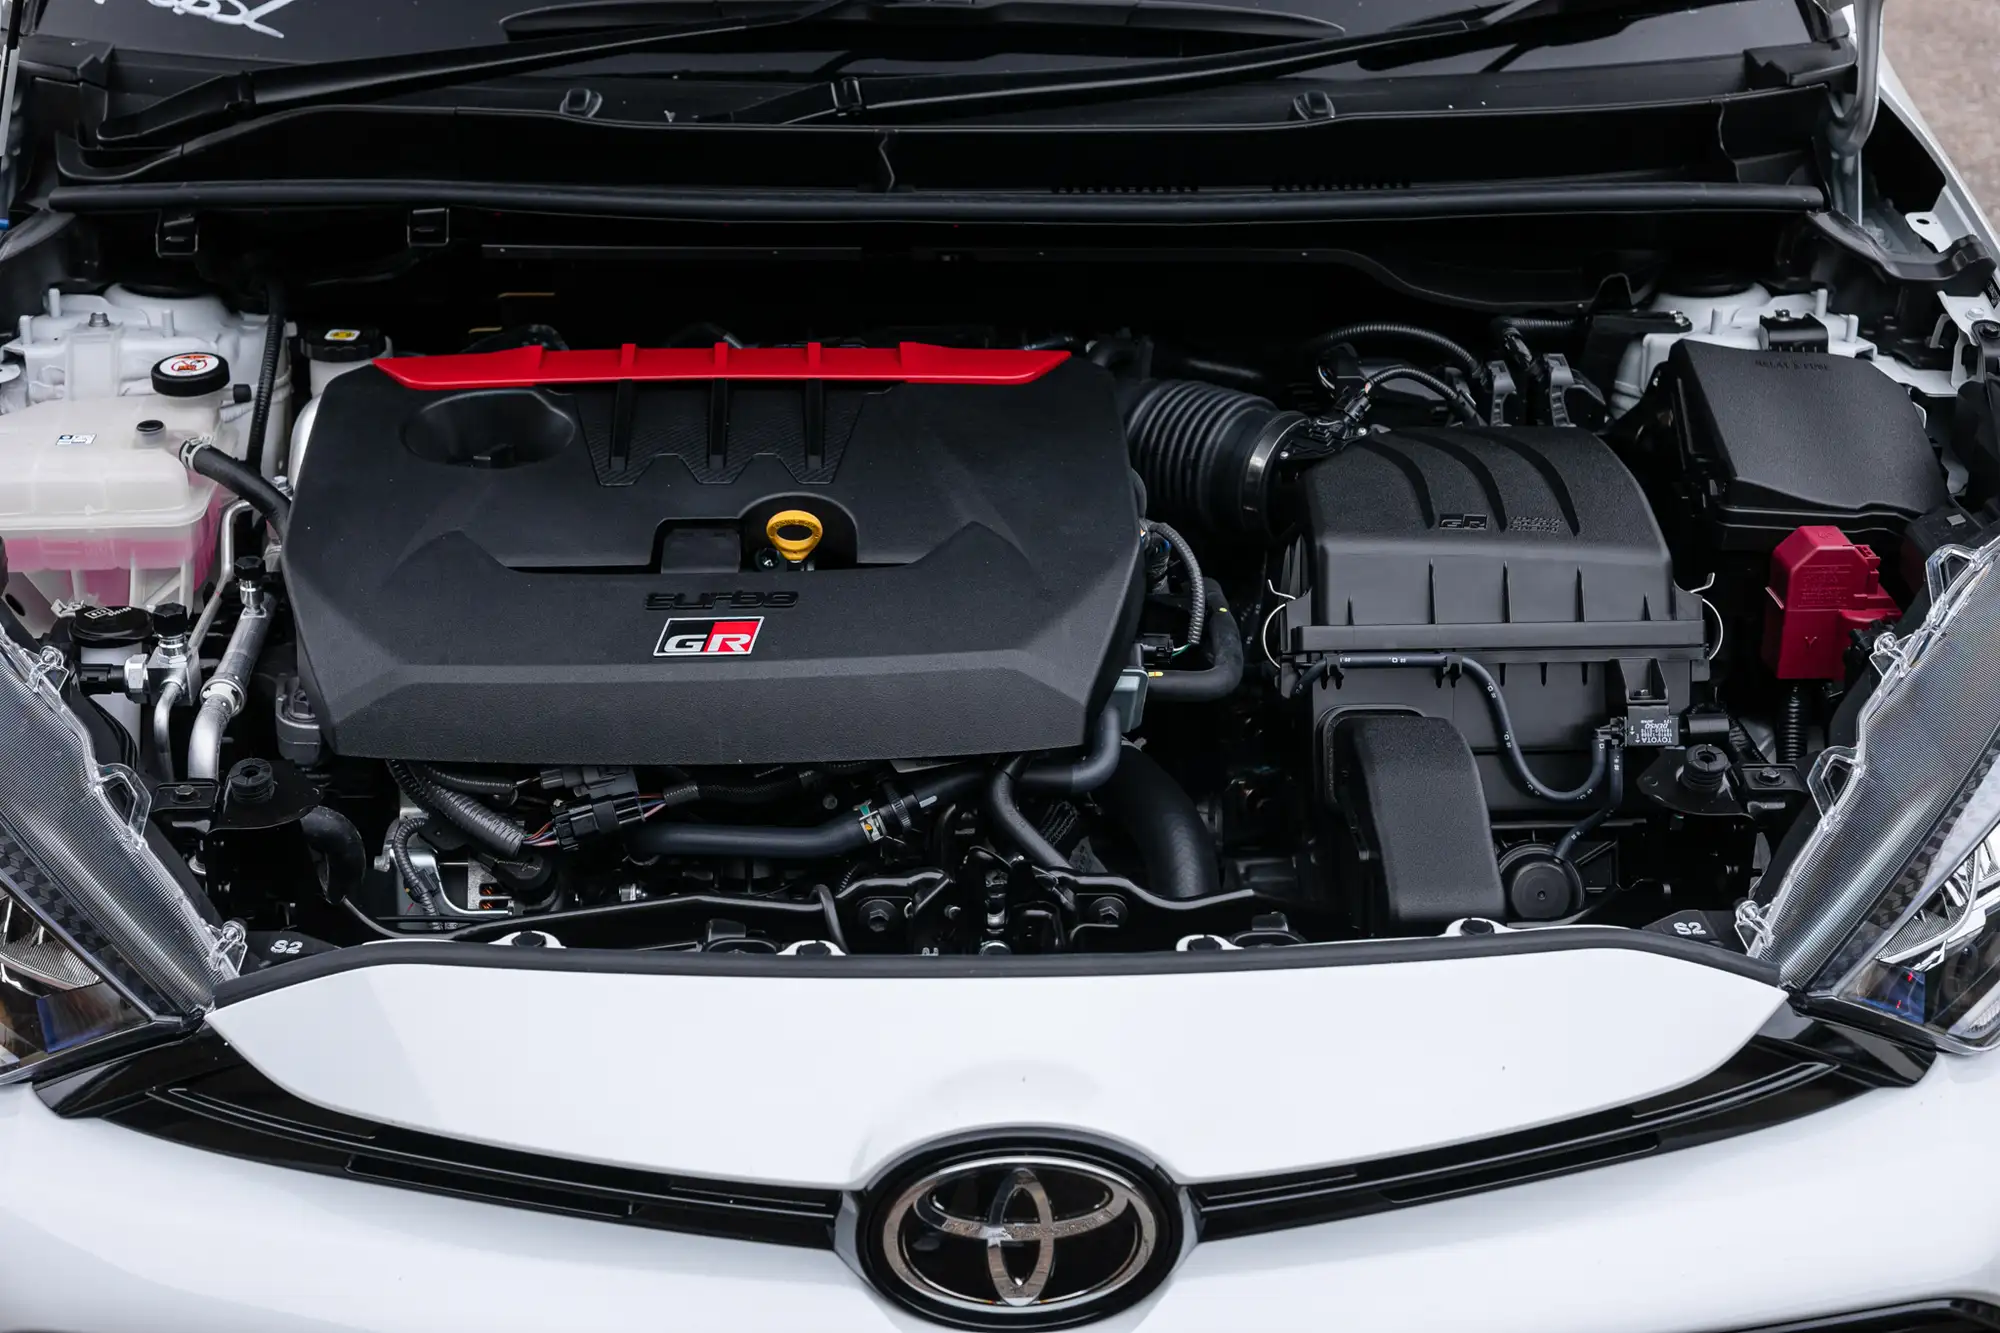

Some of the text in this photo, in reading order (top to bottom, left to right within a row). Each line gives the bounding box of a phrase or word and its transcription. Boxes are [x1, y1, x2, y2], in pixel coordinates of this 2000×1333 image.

[1440, 516, 1487, 529] GR
[645, 590, 799, 610] turbo
[663, 633, 753, 654] GR
[1673, 921, 1707, 936] S2
[270, 939, 304, 955] S2
